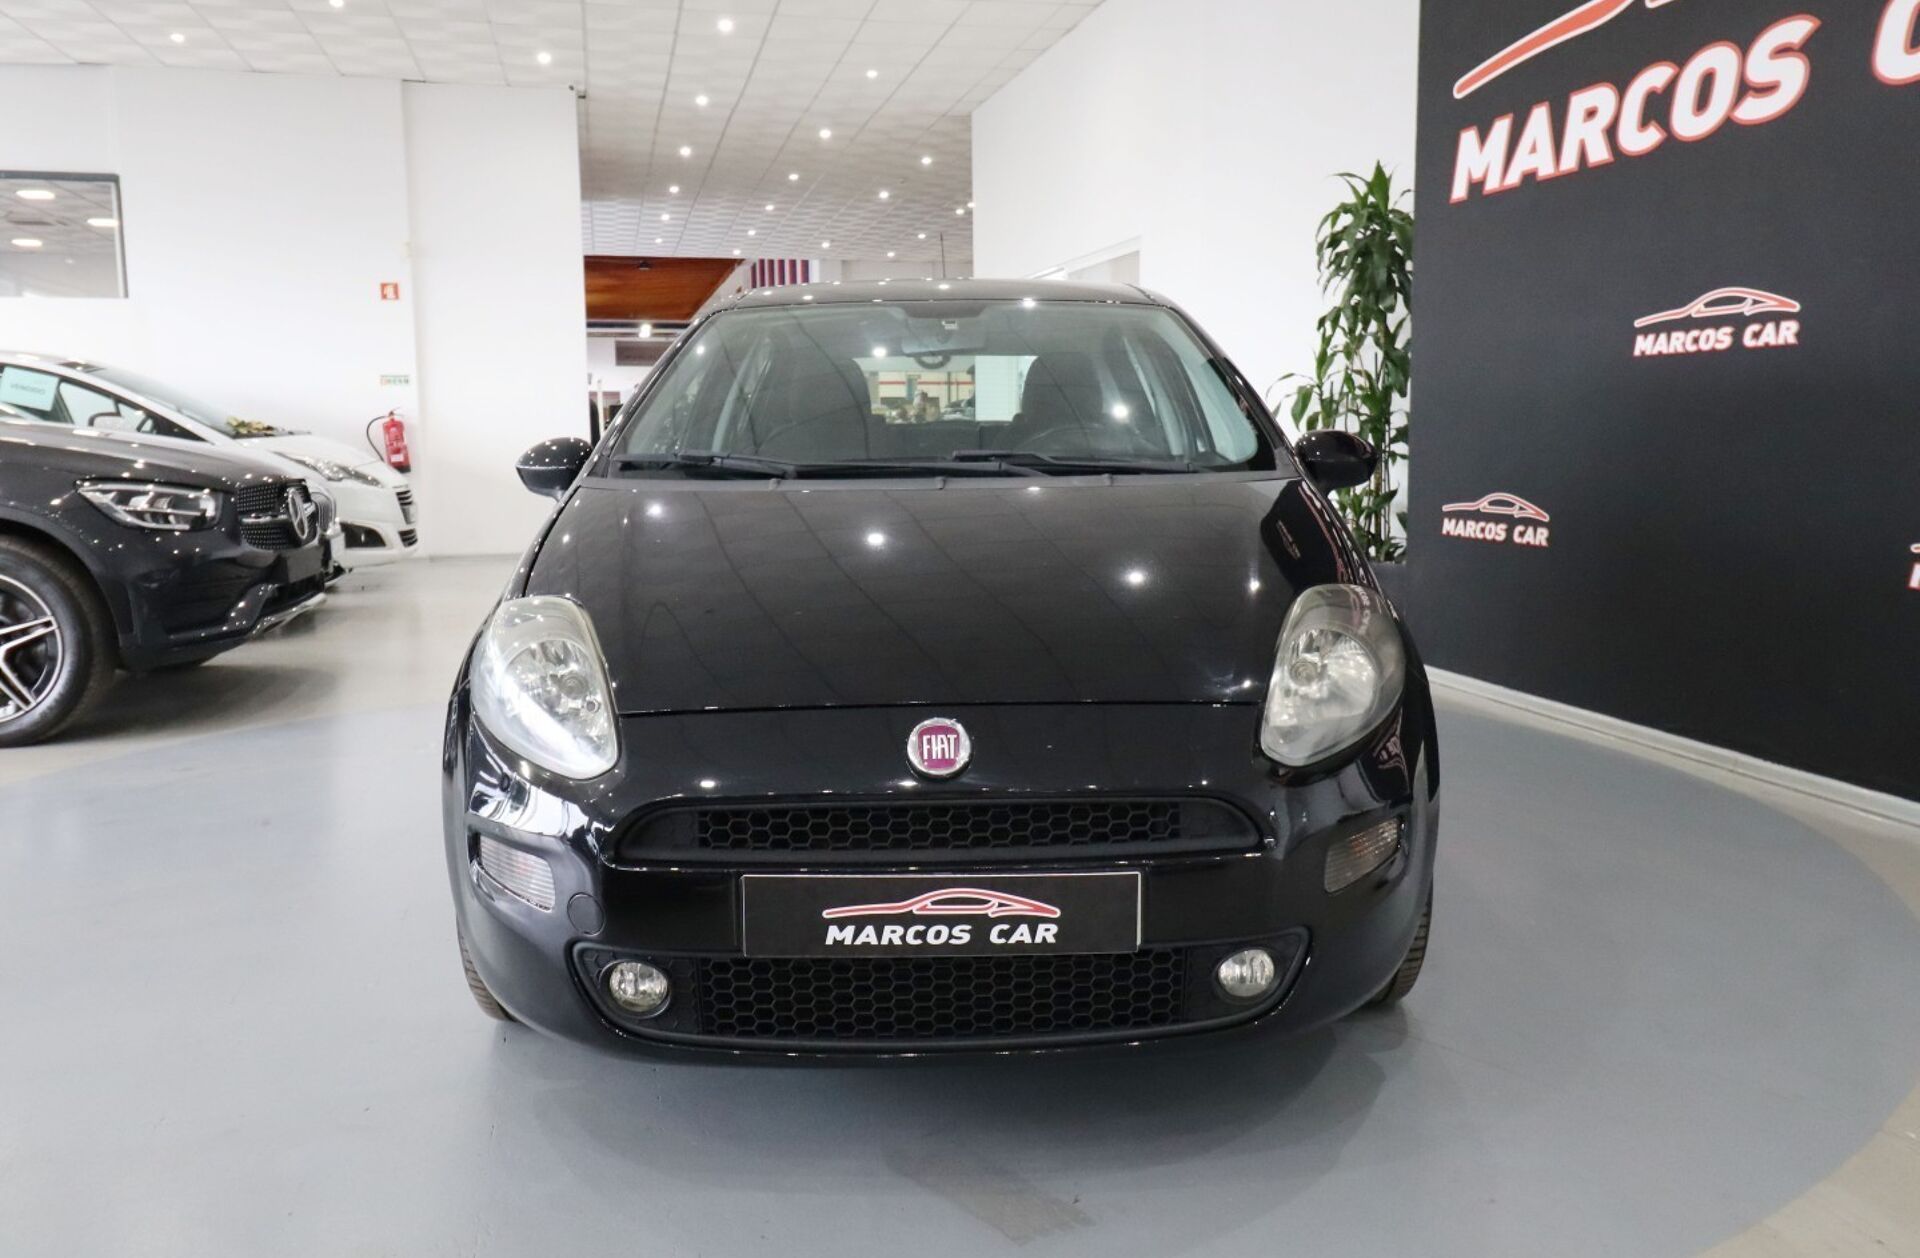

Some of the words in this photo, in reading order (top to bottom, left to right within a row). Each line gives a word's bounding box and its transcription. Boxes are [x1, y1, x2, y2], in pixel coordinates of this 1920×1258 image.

[1450, 13, 1822, 204] MARCOS
[1632, 325, 1735, 357] MARCOS
[1742, 319, 1800, 349] CAR
[1441, 517, 1508, 541] MARCOS
[1512, 524, 1550, 547] CAR
[922, 734, 957, 760] FIAT
[825, 924, 972, 946] MARCOS
[989, 923, 1059, 944] CAR
